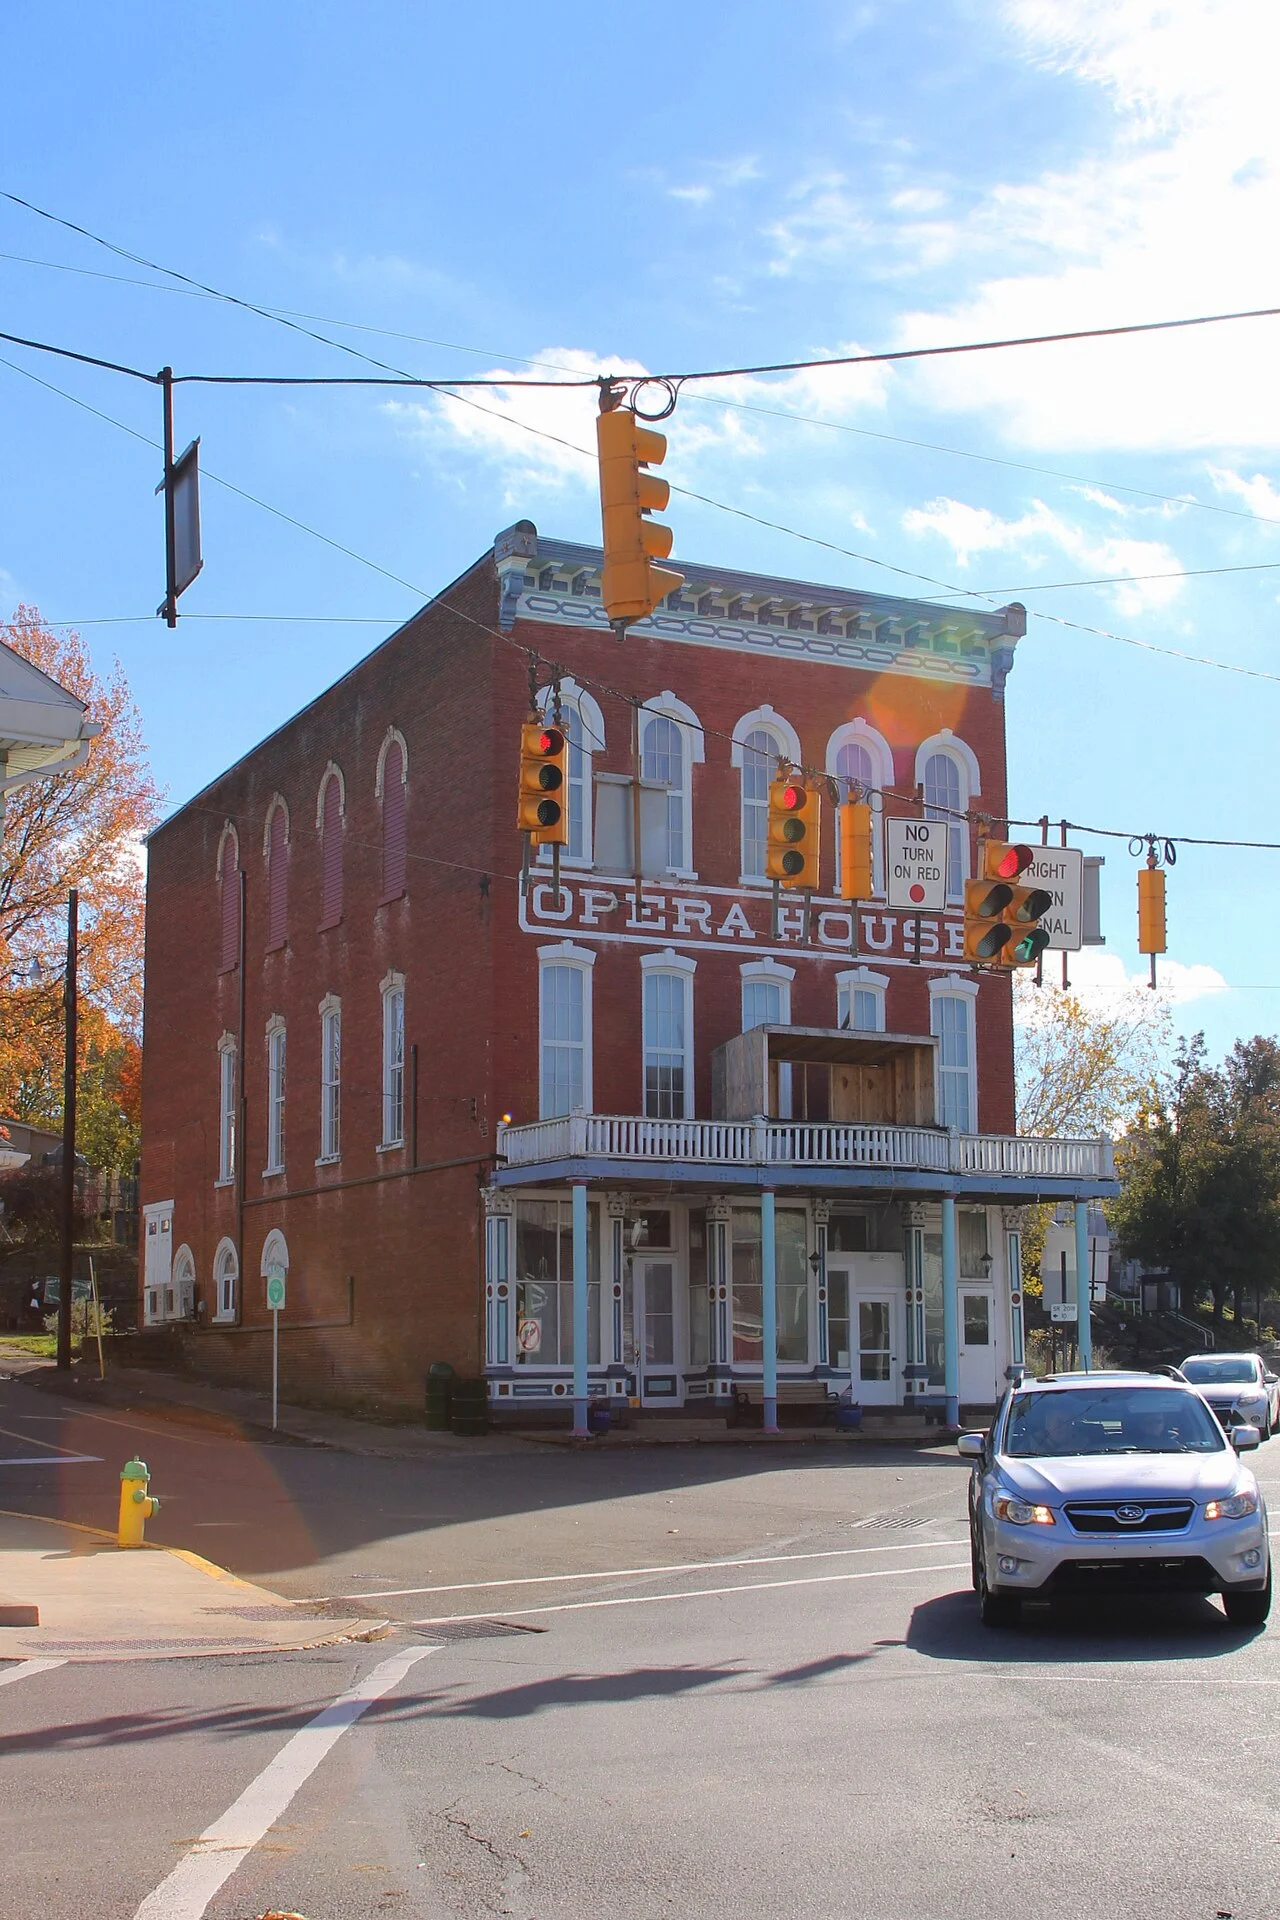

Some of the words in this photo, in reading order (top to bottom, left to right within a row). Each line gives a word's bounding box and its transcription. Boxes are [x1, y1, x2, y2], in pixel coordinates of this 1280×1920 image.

[906, 825, 929, 842] NO
[902, 847, 933, 862] TURN
[894, 865, 911, 878] ON
[918, 867, 940, 880] RED
[1027, 862, 1067, 879] RIGHT
[532, 884, 755, 938] OPERA
[776, 907, 964, 956] HOUSE
[1037, 917, 1072, 935] GNAL
